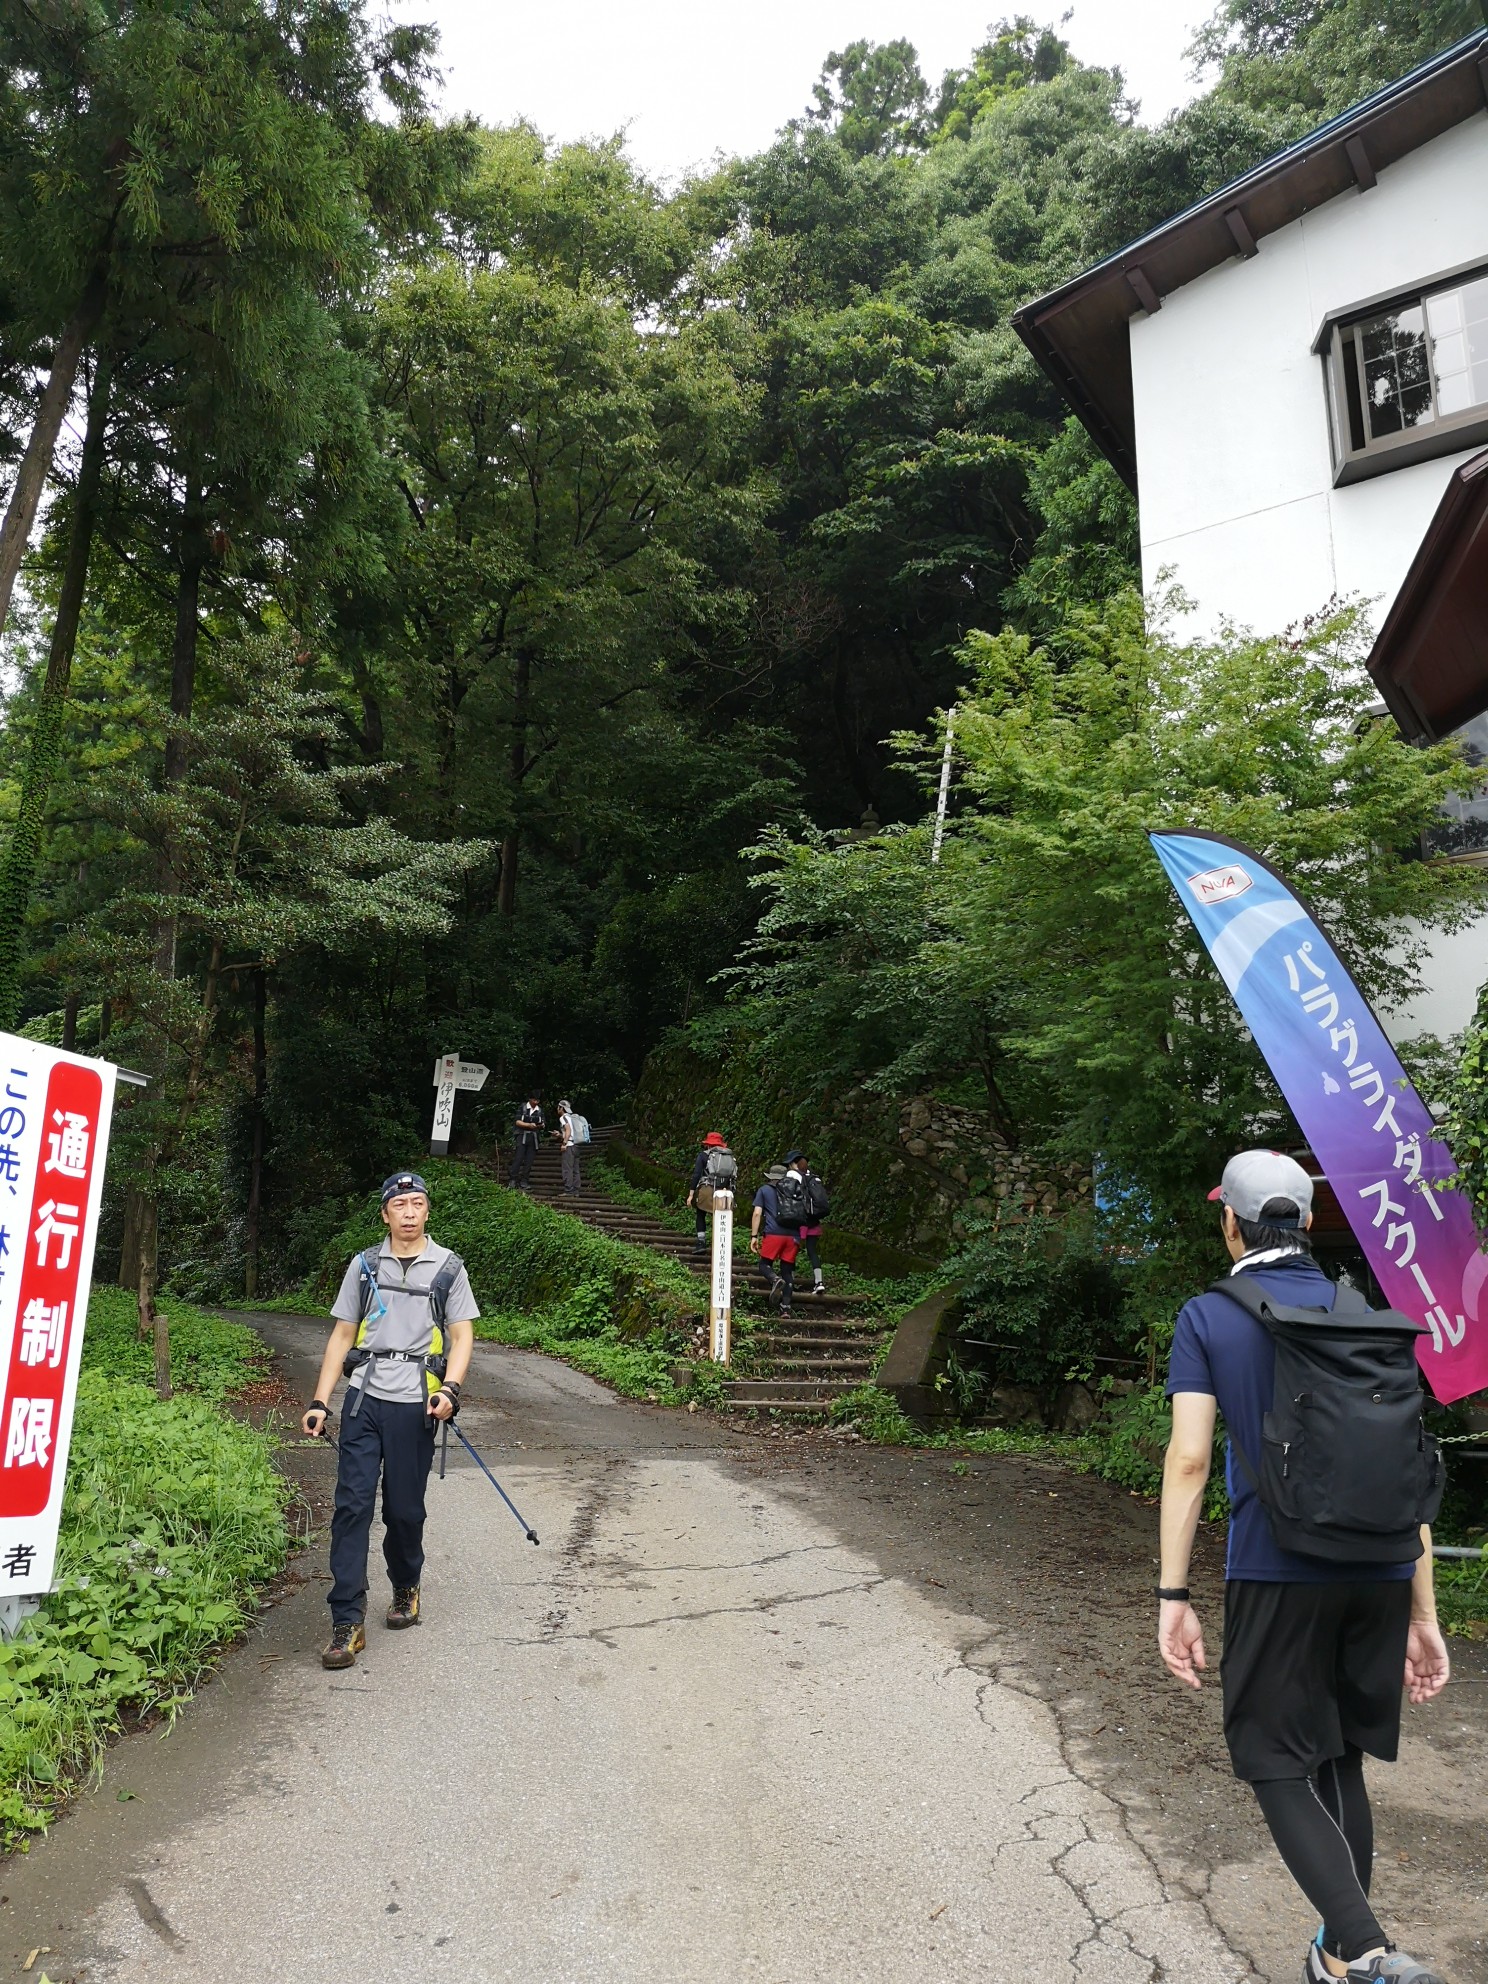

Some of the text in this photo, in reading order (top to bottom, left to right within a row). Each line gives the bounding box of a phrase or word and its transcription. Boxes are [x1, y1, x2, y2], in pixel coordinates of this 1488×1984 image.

[436, 1081, 454, 1128] 伊吹山
[1282, 941, 1444, 1222] パラグライダー
[4, 1107, 89, 1471] 通行制限
[1358, 1179, 1466, 1354] スクール
